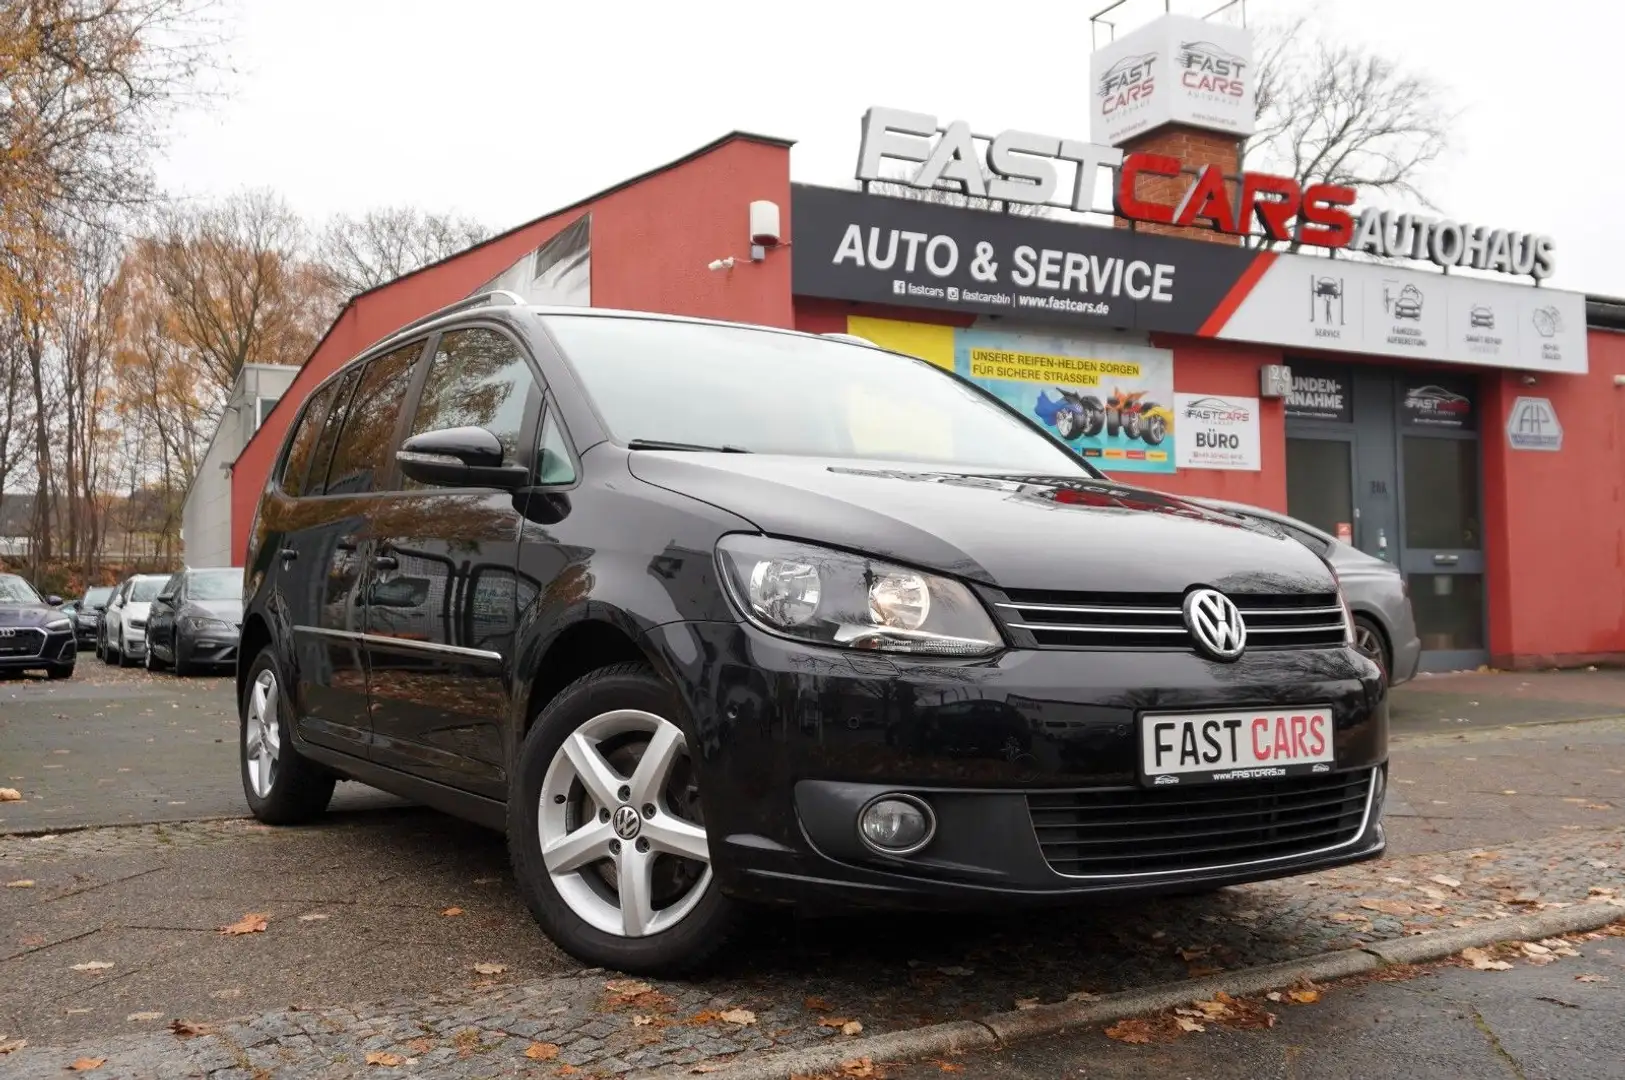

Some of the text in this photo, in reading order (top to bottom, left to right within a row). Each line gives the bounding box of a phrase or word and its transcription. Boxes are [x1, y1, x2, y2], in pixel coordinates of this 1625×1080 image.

[1101, 57, 1157, 97] FAST
[1183, 52, 1247, 79] FAST
[1102, 77, 1155, 116] CARS
[1182, 71, 1244, 98] CARS
[1354, 206, 1557, 279] AUTOHAUS
[832, 223, 1176, 301] AUTO & SERVICE
[907, 283, 945, 298] fastcars
[1019, 294, 1110, 315] www.fastcars.de
[972, 351, 1140, 376] UNSERE REIFEN-HELDEN SORGEN
[972, 363, 1099, 385] FÜR SICHERE STRASSEN!
[1291, 376, 1343, 394] UNDEN-
[1284, 391, 1344, 409] NNAHME
[1196, 427, 1240, 450] BÜRO
[1154, 714, 1326, 768] FAST CARS
